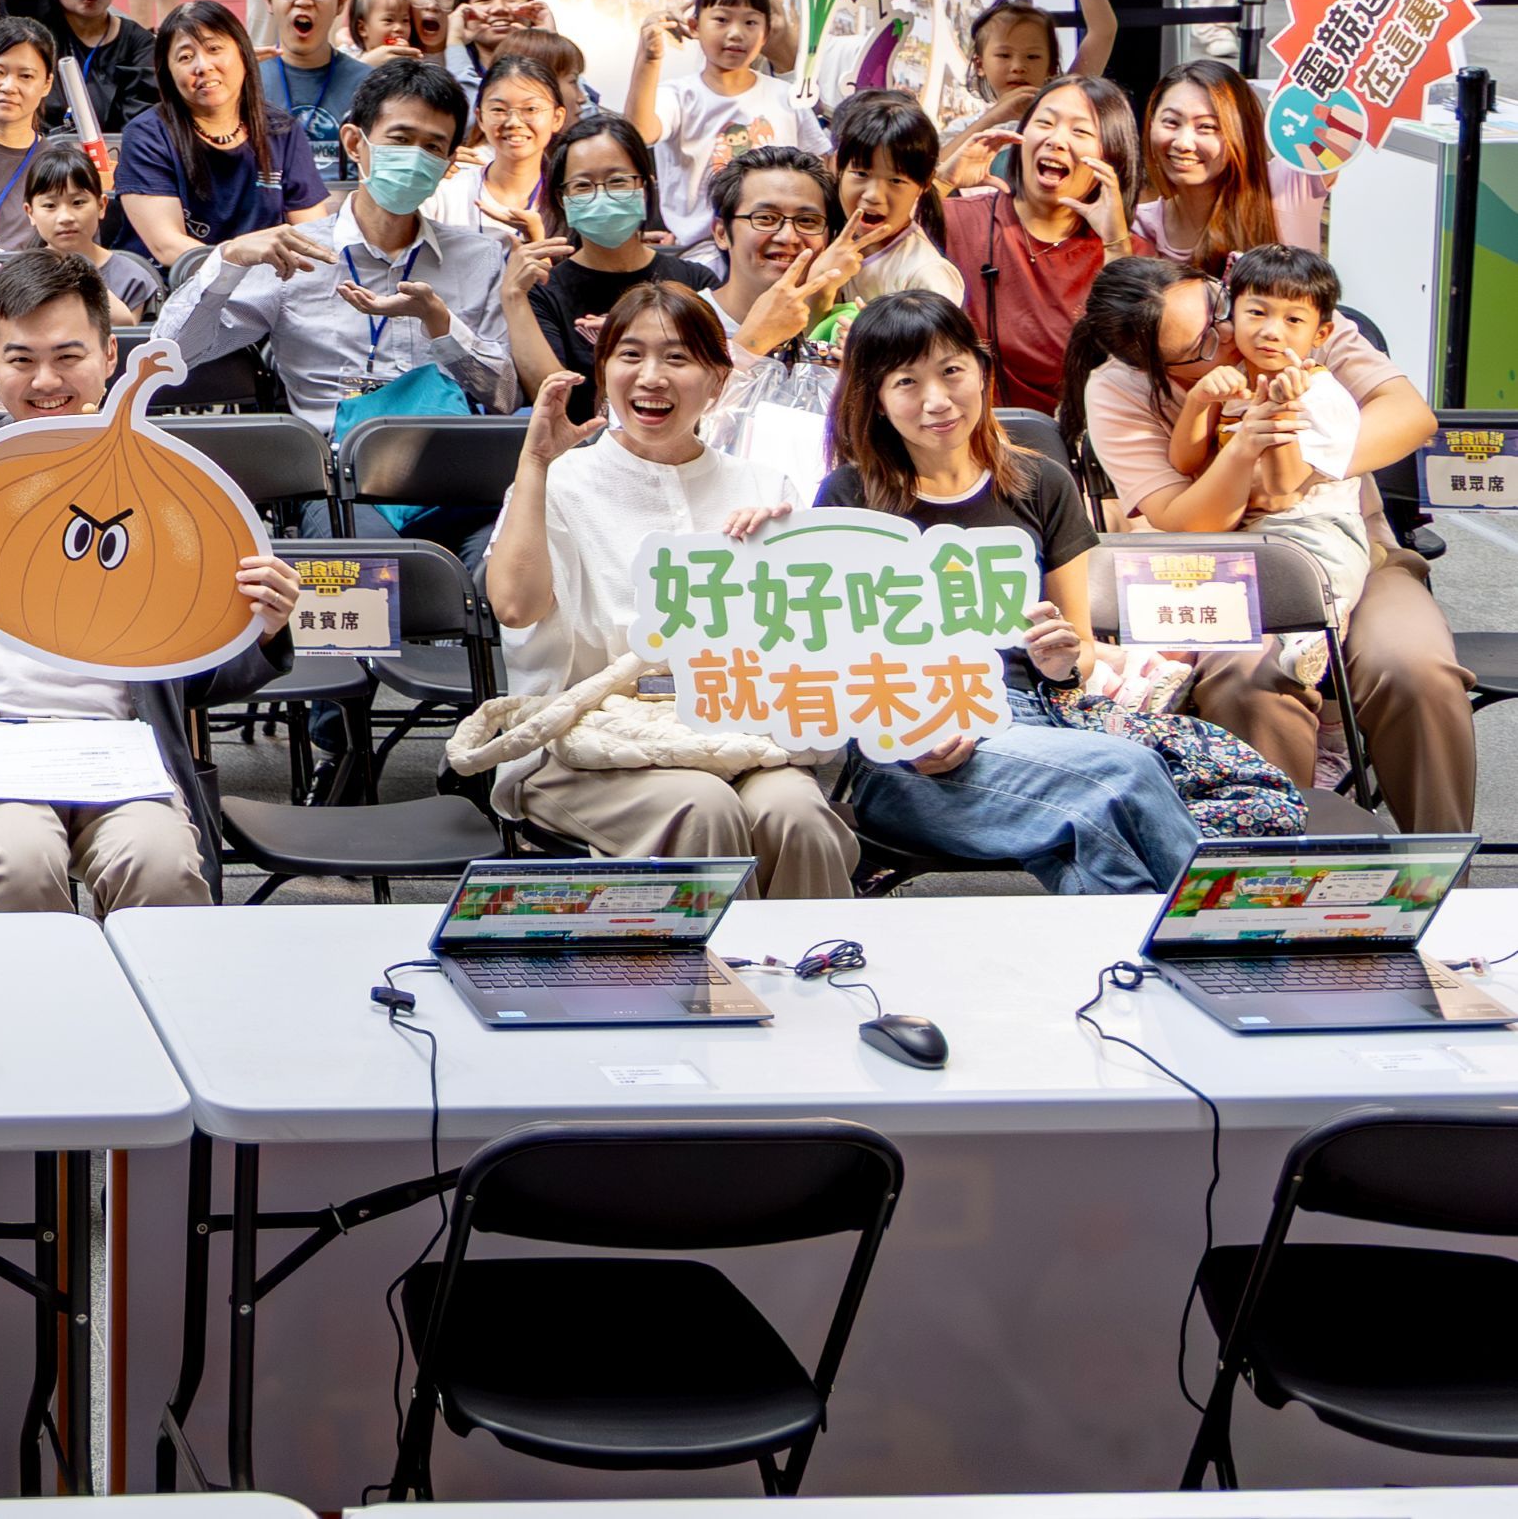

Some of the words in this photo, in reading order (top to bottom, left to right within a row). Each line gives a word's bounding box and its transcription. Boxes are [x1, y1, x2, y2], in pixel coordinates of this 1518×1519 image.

[1451, 474, 1505, 492] 觀眾席
[649, 543, 1034, 653] 好好吃飯
[298, 610, 359, 631] 貴賓席
[1157, 605, 1218, 625] 貴賓席
[693, 647, 1001, 748] 就有未來
